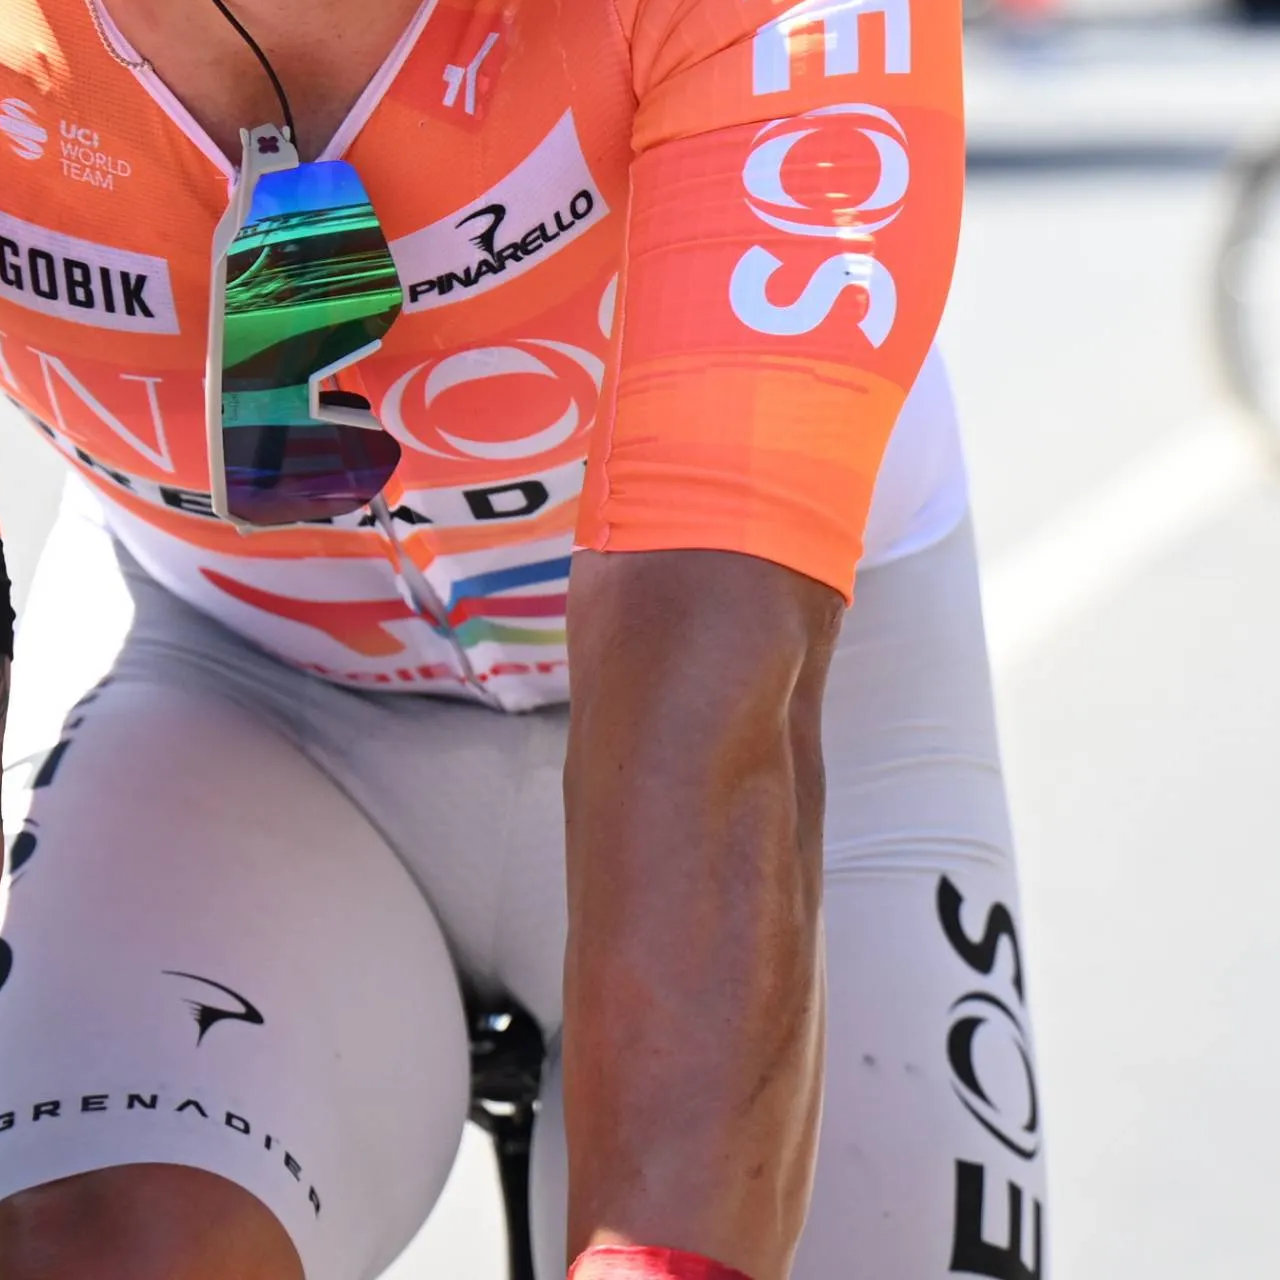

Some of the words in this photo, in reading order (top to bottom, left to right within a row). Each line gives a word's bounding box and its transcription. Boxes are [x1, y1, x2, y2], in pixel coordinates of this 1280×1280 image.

[60, 119, 100, 148] UCI
[59, 158, 114, 191] TEAM
[60, 139, 132, 176] WORLD
[409, 189, 593, 303] PINARELLO
